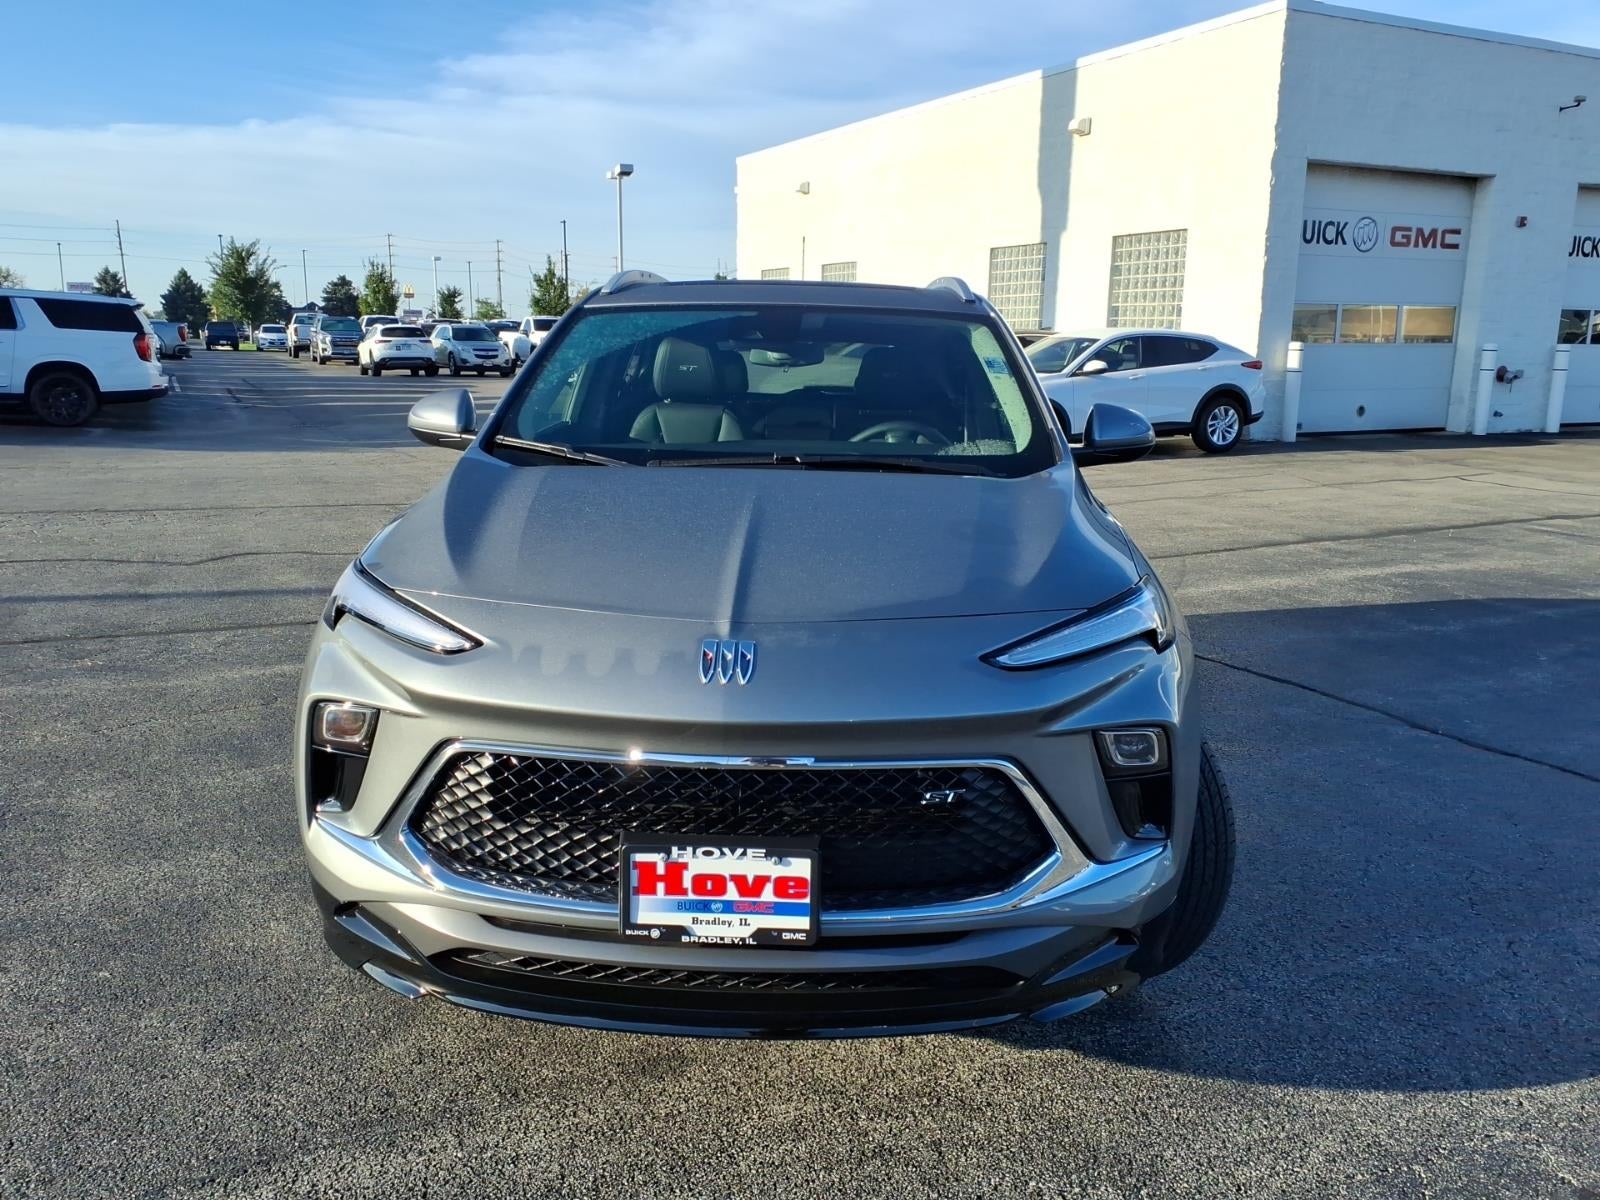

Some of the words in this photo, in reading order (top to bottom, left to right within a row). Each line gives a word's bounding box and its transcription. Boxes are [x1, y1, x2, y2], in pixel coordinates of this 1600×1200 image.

[1302, 219, 1349, 246] UICK
[1389, 226, 1461, 249] GMC
[1568, 235, 1600, 258] UICK
[672, 846, 766, 860] HOVE
[632, 861, 809, 899] Hove
[677, 901, 710, 912] BUICK
[733, 902, 774, 913] GMC
[691, 916, 735, 928] Bradley,
[739, 918, 750, 927] IL
[682, 935, 742, 945] BRADLEY,
[745, 937, 757, 945] IL
[782, 932, 806, 940] GMC
